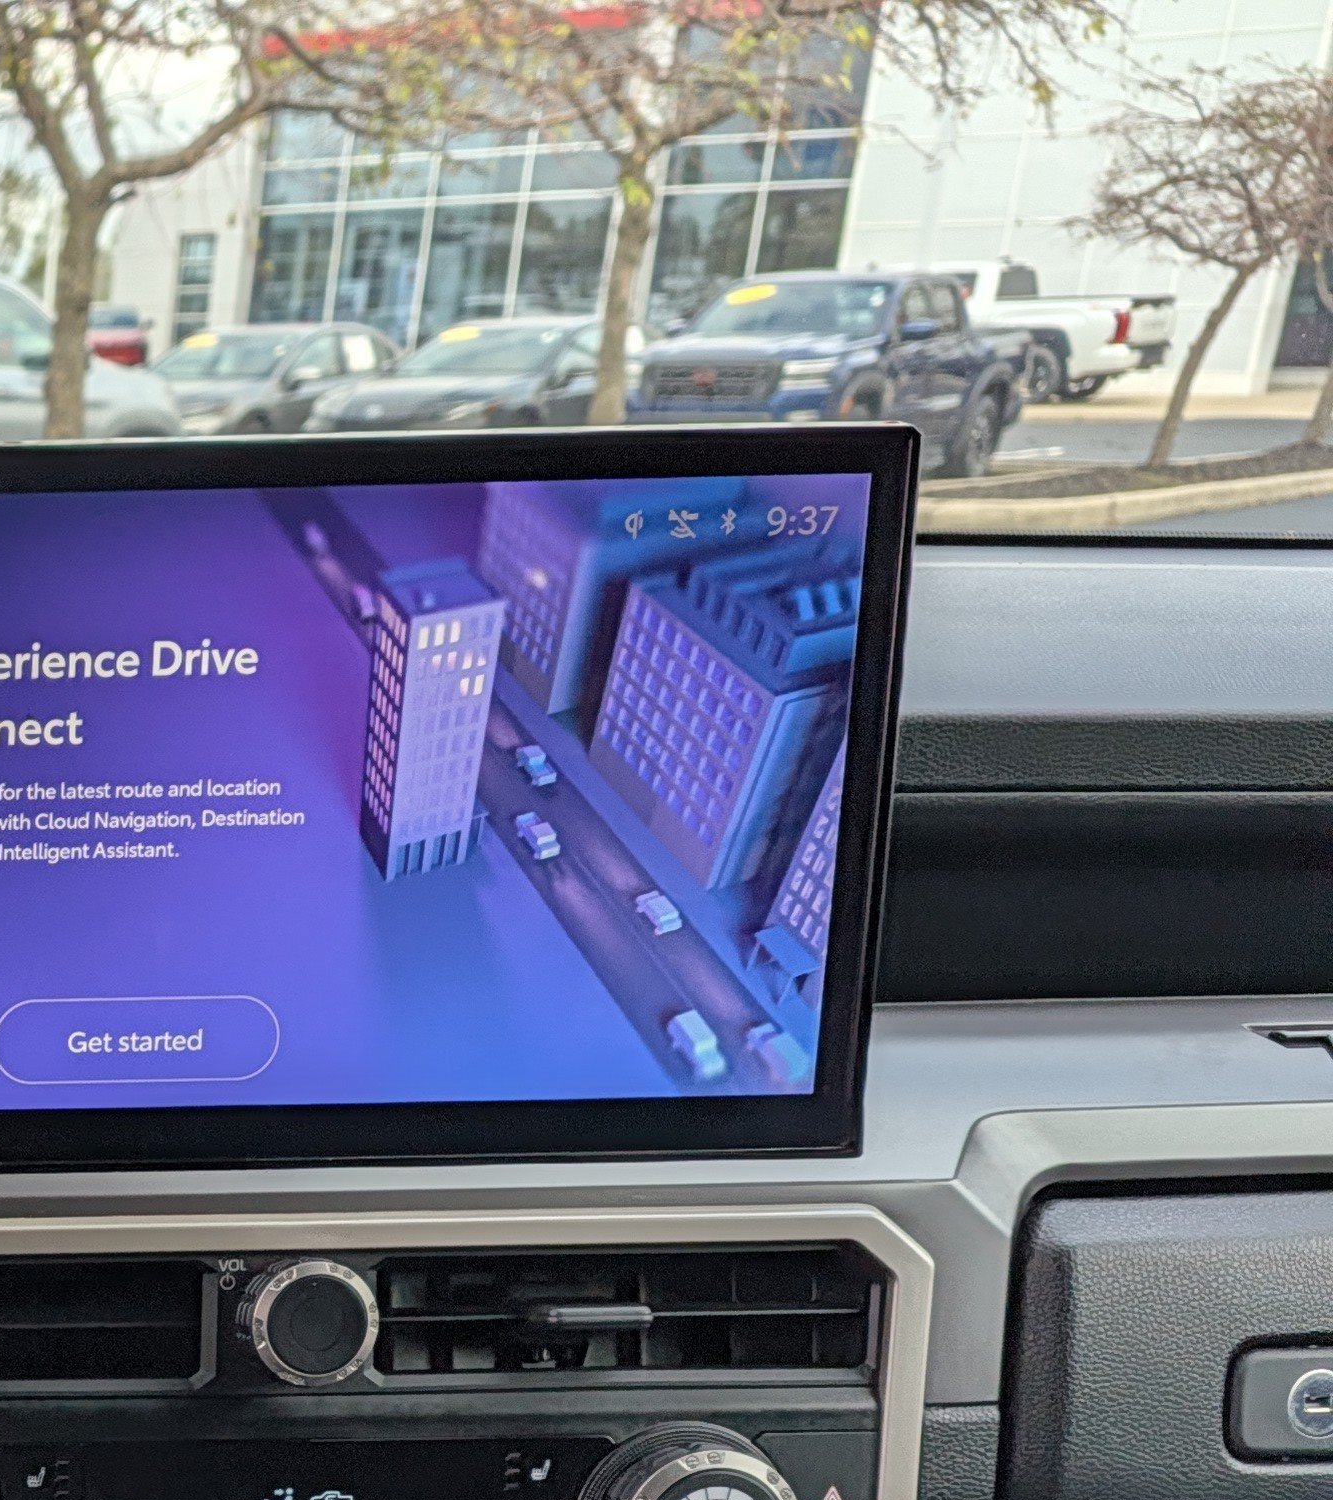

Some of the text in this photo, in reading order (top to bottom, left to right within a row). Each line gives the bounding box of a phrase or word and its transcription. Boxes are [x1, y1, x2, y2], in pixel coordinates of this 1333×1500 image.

[766, 506, 839, 536] 9:37
[151, 638, 259, 677] Drive
[26, 782, 57, 800] the
[60, 781, 111, 800] latest
[115, 782, 164, 798] route
[167, 779, 203, 797] and
[207, 778, 281, 797] location
[35, 811, 91, 830] Cloud
[94, 810, 197, 833] Navigation,
[201, 808, 305, 827] Destination
[92, 841, 180, 859] Assistant.
[68, 1028, 203, 1053] Get started
[218, 1258, 246, 1272] VOL
